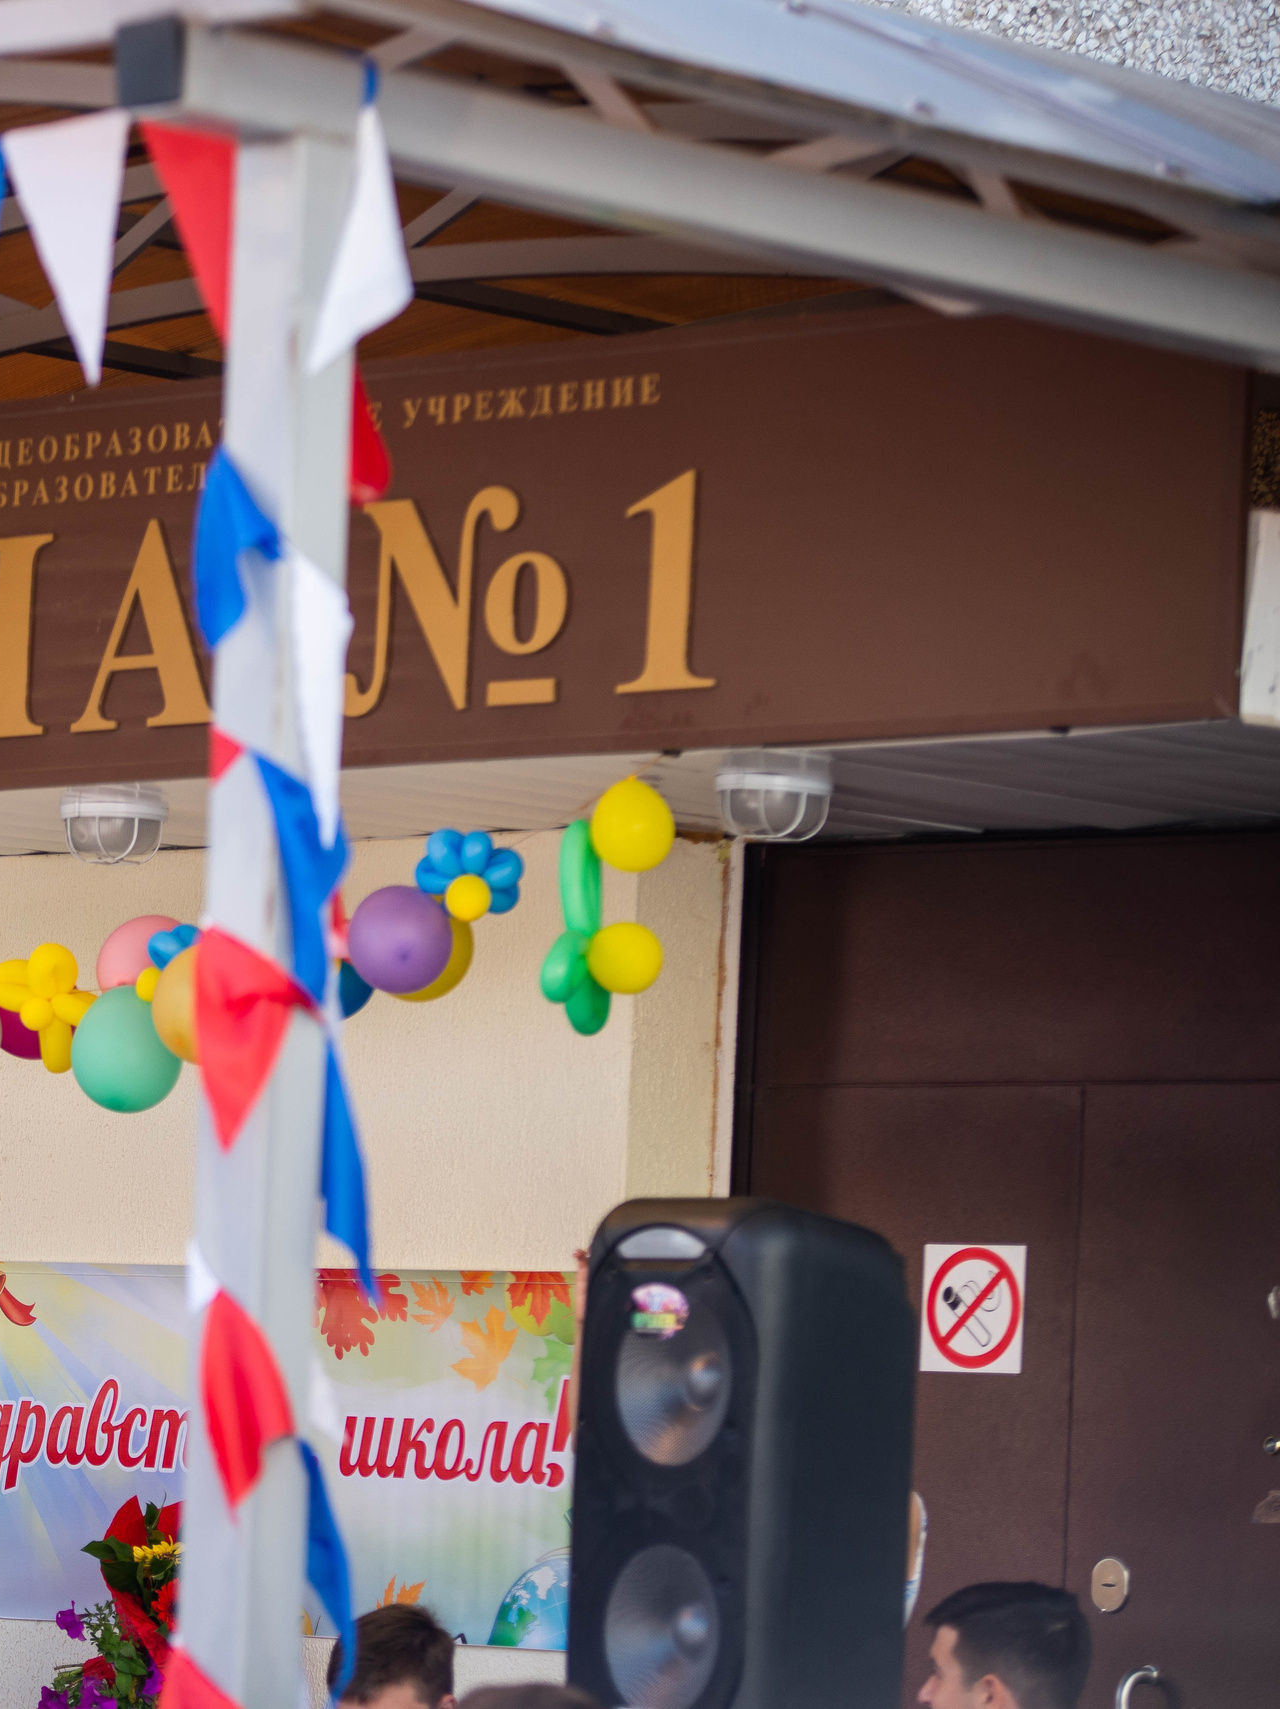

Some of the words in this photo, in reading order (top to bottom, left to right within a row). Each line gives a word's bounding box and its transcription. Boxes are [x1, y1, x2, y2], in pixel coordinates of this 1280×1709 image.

[402, 373, 662, 430] УЧРЕЖДЕНИЕ
[343, 485, 569, 718] №
[614, 468, 717, 694] 1
[339, 1378, 571, 1488] школа!
